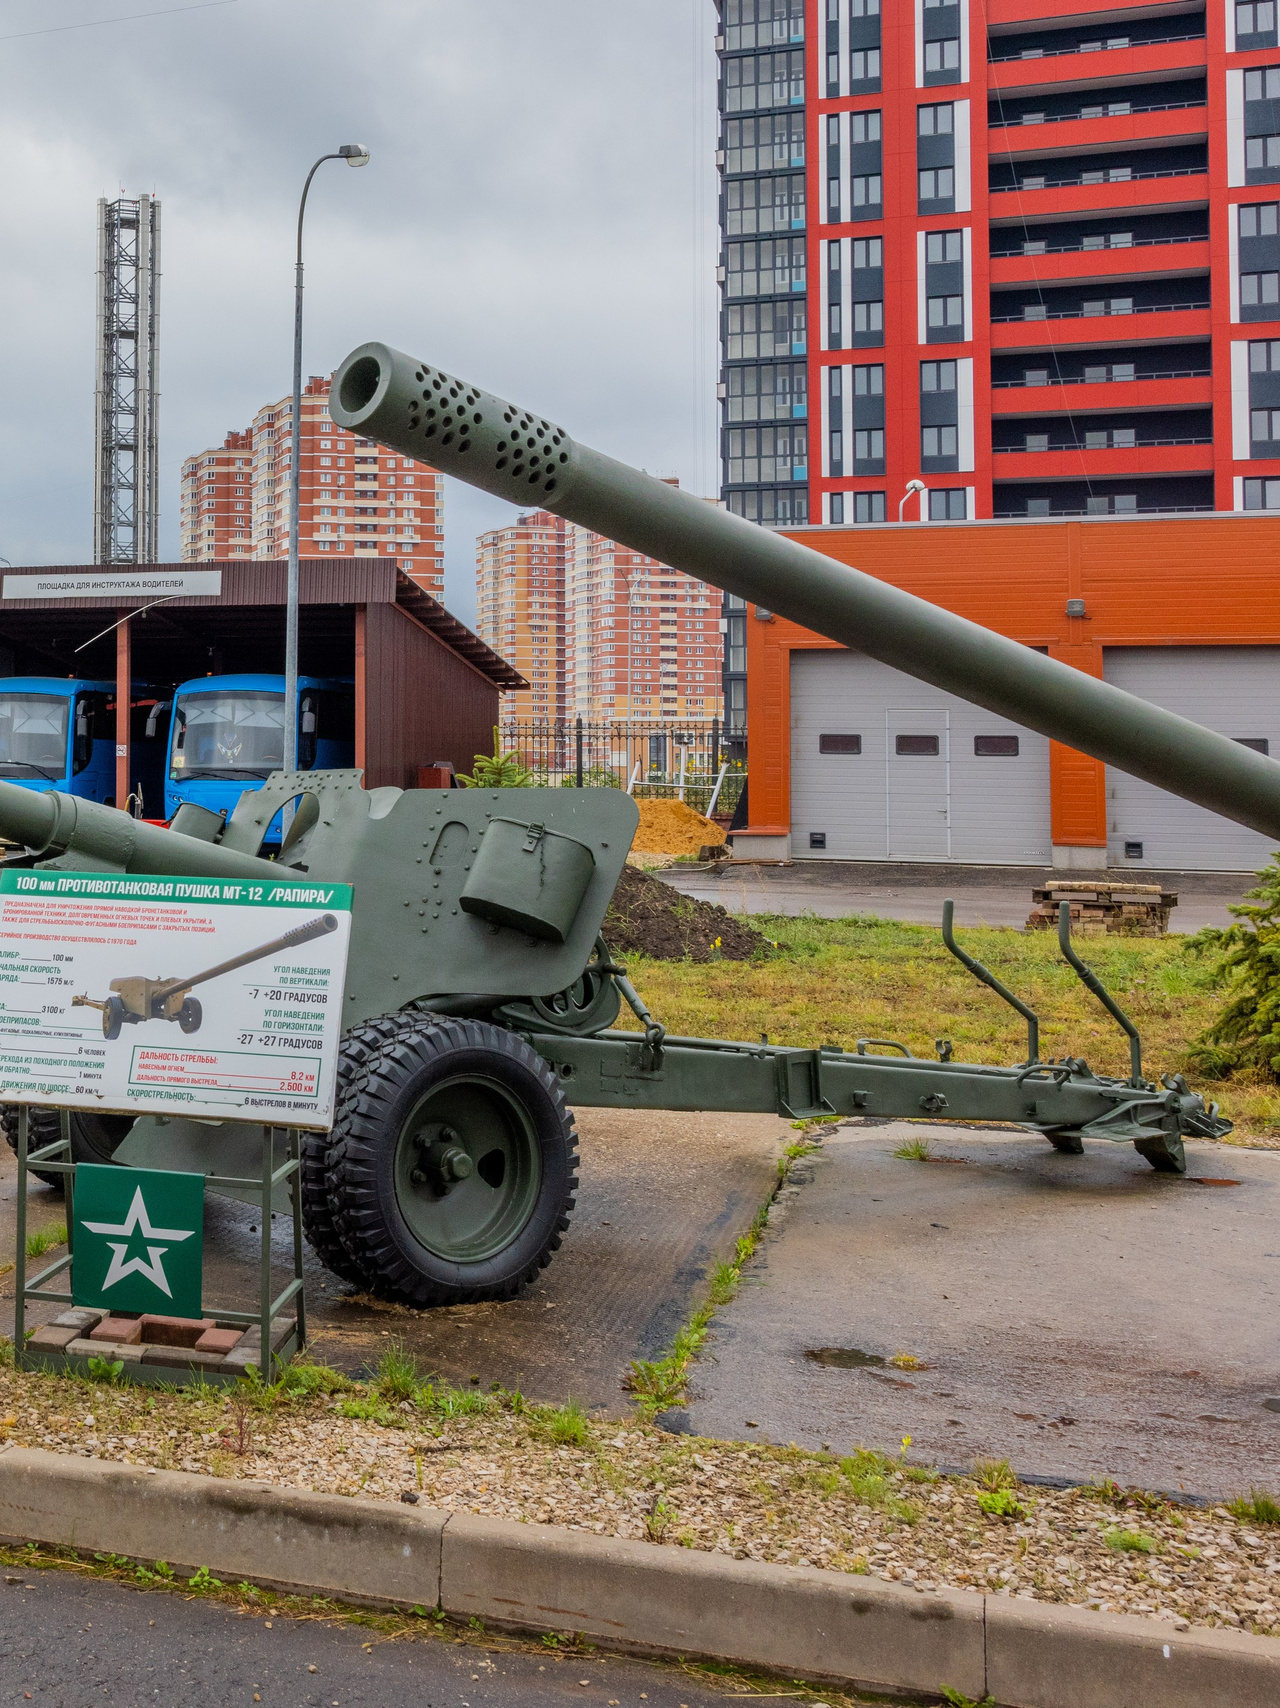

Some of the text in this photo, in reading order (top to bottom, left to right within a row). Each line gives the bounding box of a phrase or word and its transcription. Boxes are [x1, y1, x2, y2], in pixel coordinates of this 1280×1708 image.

[37, 579, 184, 590] ПЛОЩАДКА ДЛЯ ИНСТРУКТАЖА ВОДИТЕЛЕЙ
[15, 876, 38, 890] 100
[56, 878, 173, 896] ПРОТИВОТАНКОВАЯ
[174, 883, 220, 898] ПУШКА
[222, 885, 263, 900] МТ-12
[267, 887, 333, 903] /РАПИРА/
[4, 900, 44, 908] ПРЕДНАЗНАЧЕНА
[141, 906, 182, 914] БРОНЕТАНКОВОЙ
[2, 908, 43, 916] БРОНИРОВАННОЙ
[67, 911, 114, 919] ДОЛГОВРЕМЕННЫХ
[182, 916, 207, 924] УКРЫТИЙ,
[117, 922, 157, 930] БОЕПРИПАСАМИ
[191, 925, 216, 933] ПОЗИЦИЙ.
[22, 933, 60, 941] ПРОИЗВОДСТВО
[60, 935, 106, 943] ОСУЩЕСТВЛЯЛОСЬ
[52, 953, 64, 961] 100
[29, 965, 62, 974] СКОРОСТЬ
[273, 965, 330, 976] УГОЛ НАВЕДЕНИЯ
[46, 977, 63, 985] 1575
[289, 977, 329, 986] ВЕРТИКАЛИ:
[248, 988, 328, 1004] -7 +20 ГРАДУСОВ
[41, 1005, 58, 1014] 3100
[264, 1009, 325, 1020] УГОЛ НАВЕДЕНИЯ
[262, 1020, 324, 1032] ПО ГОРИЗОНТАЛИ:
[236, 1033, 323, 1050] -27 +27 ГРАДУСОВ
[77, 1046, 83, 1054] 6
[23, 1056, 32, 1064] ИЗ
[32, 1057, 67, 1066] ПОХОДНОГО
[67, 1059, 105, 1069] ПОЛОЖЕНИЯ
[139, 1051, 218, 1064] ДАЛЬНОСТЬ СТРЕЛЬБЫ:
[3, 1065, 31, 1074] ОБРАТНО:
[290, 1071, 303, 1081] 8,2
[0, 1080, 37, 1090] ДВИЖЕНИЯ
[37, 1083, 46, 1091] ПО
[46, 1084, 71, 1093] ШОССЕ:
[75, 1086, 83, 1094] 60
[136, 1074, 166, 1082] ДАЛЬНОСТЬ
[166, 1076, 190, 1084] ПРЯМОГО
[190, 1078, 217, 1086] ВЫСТРЕЛА
[279, 1081, 302, 1092] 2,500
[126, 1088, 196, 1101] СКОРОСТРЕЛЬНОСТЬ:
[244, 1096, 249, 1105] 6
[250, 1098, 286, 1108] ВЫСТРЕЛОВ
[292, 1101, 318, 1110] МИНУТУ
